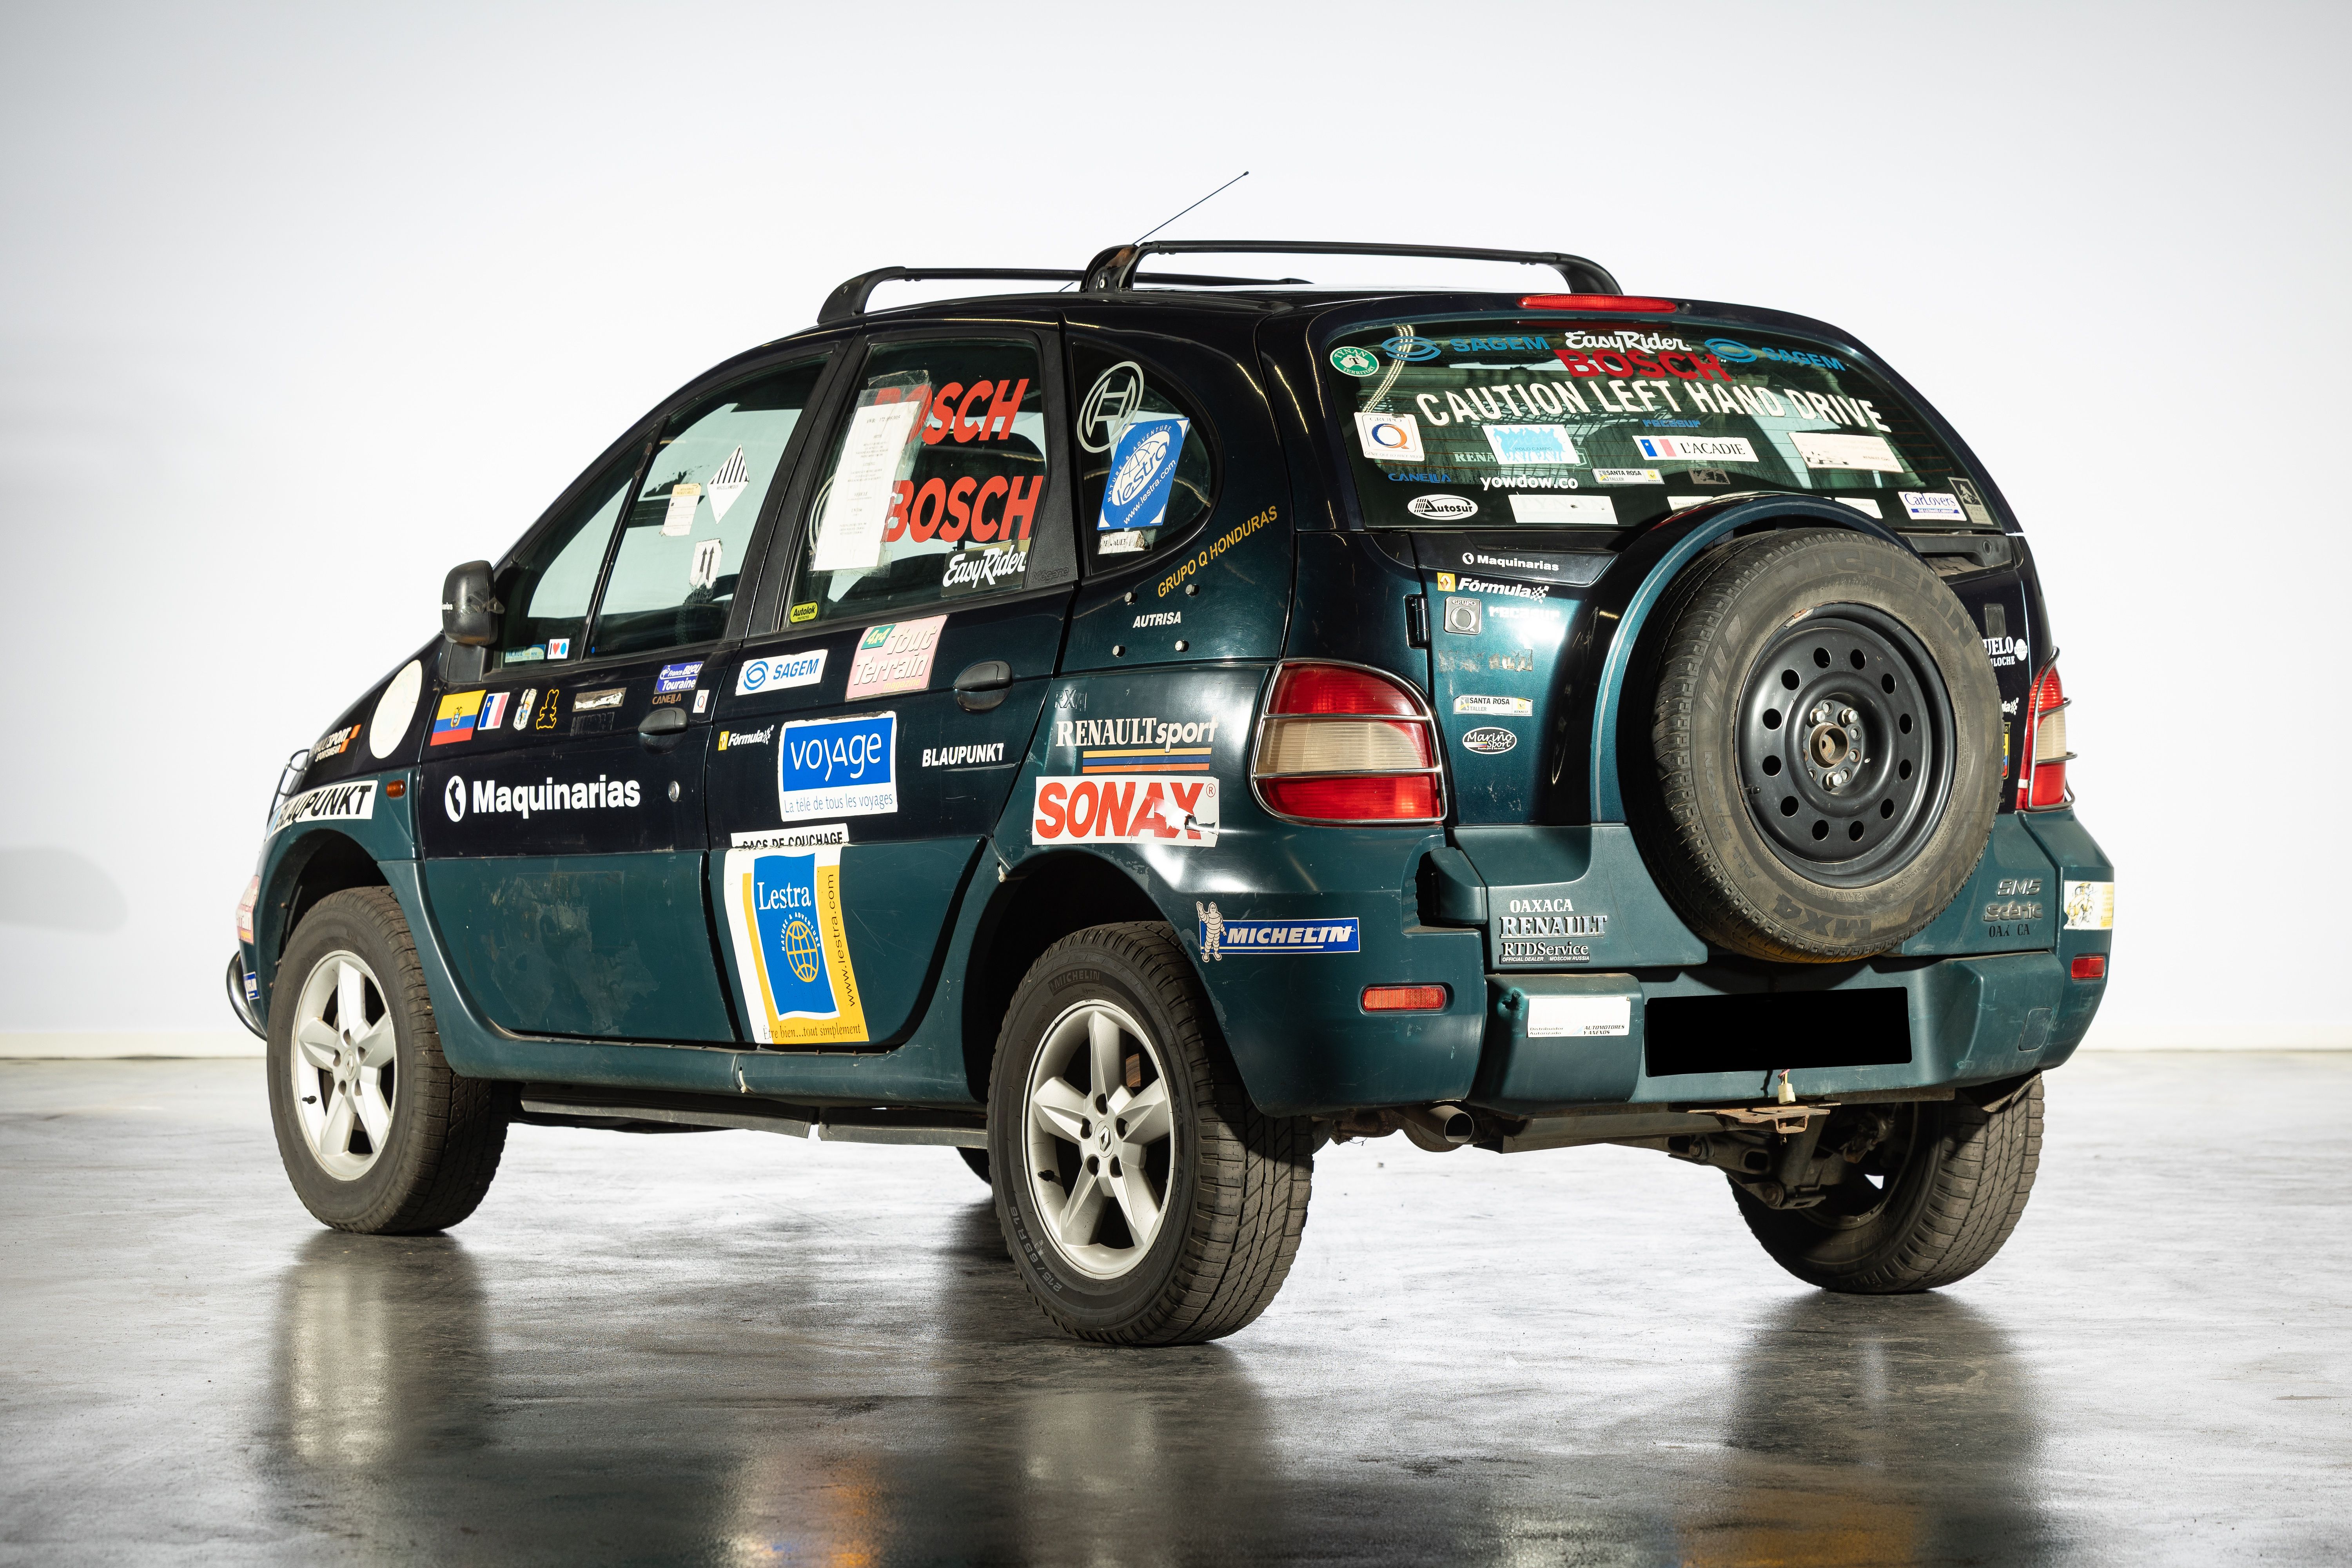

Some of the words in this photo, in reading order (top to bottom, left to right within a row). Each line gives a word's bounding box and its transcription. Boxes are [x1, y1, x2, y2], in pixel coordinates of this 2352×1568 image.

[1450, 336, 1551, 352] SAGEM
[1565, 330, 1692, 354] EasyRider
[1334, 348, 1368, 358] TYNAN
[1761, 347, 1846, 371] SAGEM
[1343, 365, 1375, 375] TERRITORY
[1553, 349, 1733, 382] BOSCH
[1416, 381, 1590, 426] CAUTION
[1589, 379, 1682, 413] LEFT
[1683, 381, 1786, 417] HAND
[1783, 388, 1892, 433] DRIVE
[1642, 419, 1701, 428] recasur
[1372, 423, 1410, 449] Q
[1679, 442, 1746, 456] L'ACADIE
[1107, 465, 1123, 502] NATURE
[1133, 425, 1172, 452] ADVENTURE
[1388, 473, 1451, 483] CANELLA
[1480, 474, 1579, 491] yowdow.co
[1123, 459, 1176, 524] www.lestra.com
[1904, 493, 1956, 506] CarLovers
[884, 475, 1044, 543] BOSCH
[1418, 499, 1473, 512] Autosur
[1158, 559, 1196, 598] GRUPO
[1198, 551, 1208, 567] Q
[1210, 505, 1278, 560] HONDURAS
[942, 544, 1027, 588] EasyRider
[1477, 555, 1559, 571] Maquinarias
[1458, 577, 1532, 598] Fórmula
[1779, 549, 1974, 648] MICHELIN
[793, 605, 816, 617] Autolok
[1132, 612, 1181, 628] AUTRISA
[1450, 606, 1477, 632] Q
[1489, 606, 1560, 621] recasur
[866, 627, 891, 645] 4x4
[887, 625, 938, 655] Tout
[773, 658, 820, 680] SAGEM
[853, 652, 929, 686] Terrain
[662, 677, 696, 691] Touraine
[882, 678, 921, 691] magazine
[652, 693, 681, 704] CANELLA
[1054, 689, 1087, 712] RX4
[728, 729, 764, 746] Fórmula
[1466, 731, 1515, 742] Mariño
[1487, 740, 1512, 750] Sport
[790, 732, 882, 782] voyage
[922, 743, 1005, 768] BLAUPUNKT
[473, 775, 641, 819] Maquinarias
[784, 799, 794, 813] La
[797, 796, 812, 812] télé
[813, 796, 823, 810] de
[825, 796, 844, 809] tous
[845, 794, 858, 808] les
[858, 792, 893, 810] voyages
[1704, 751, 1733, 842] SEASON
[274, 785, 372, 831] BLAUPUNKT
[1035, 781, 1205, 840] SONAX
[1733, 846, 1757, 879] ALL
[1776, 862, 1791, 878] 16
[1794, 876, 1804, 889] R
[1904, 867, 1920, 882] RADIAL
[1896, 880, 1906, 890] X
[1997, 879, 2043, 897] SM5
[757, 881, 811, 910] Lestra
[1510, 899, 1574, 913] OAXACA
[1982, 901, 2043, 922] Scénic
[1773, 893, 1871, 939] MX4
[781, 918, 789, 951] NATURE
[794, 911, 821, 948] ADVENTURE
[1227, 926, 1352, 944] MICHELIN
[1500, 915, 1608, 938] RENAULT
[828, 874, 855, 1007] www.lestra.com
[1503, 942, 1588, 956] RTDService
[1054, 970, 1100, 989] MICHELIN
[763, 1024, 779, 1040] Être
[820, 1023, 861, 1039] simplement
[1010, 1206, 1020, 1225] 16
[1018, 1228, 1027, 1241] R
